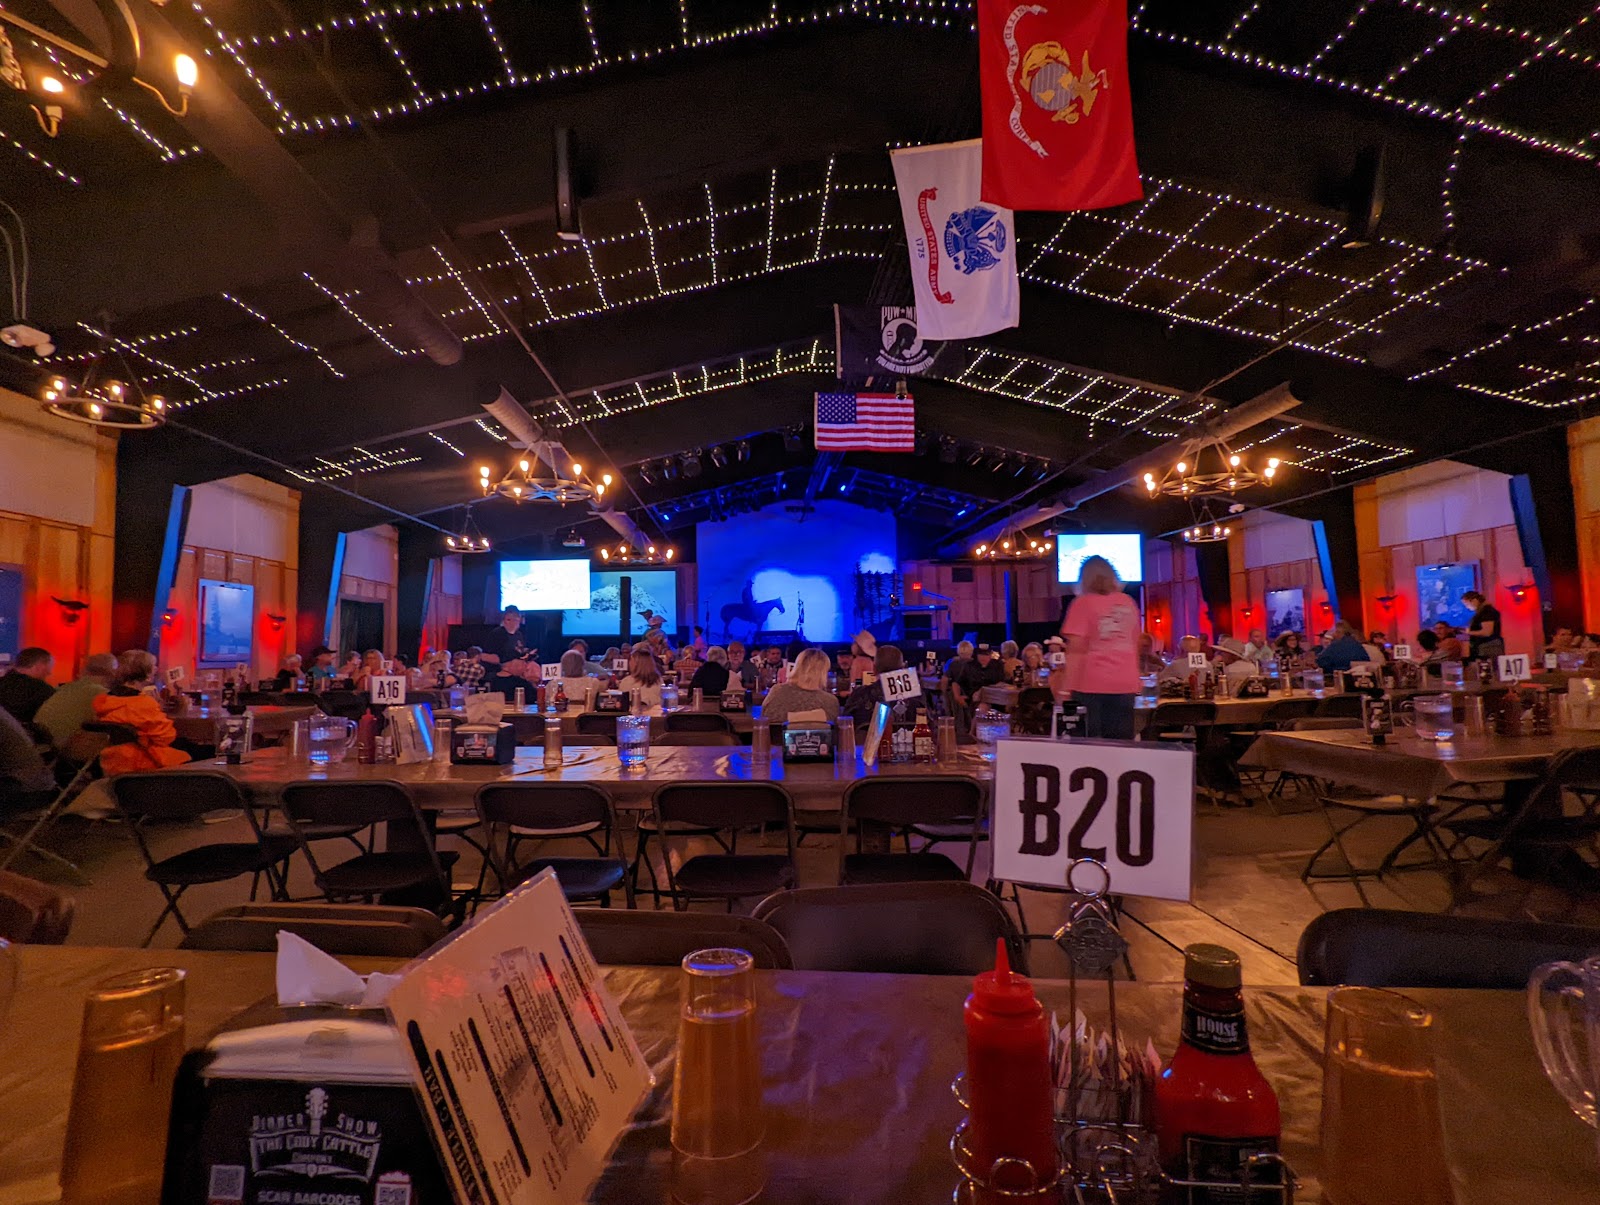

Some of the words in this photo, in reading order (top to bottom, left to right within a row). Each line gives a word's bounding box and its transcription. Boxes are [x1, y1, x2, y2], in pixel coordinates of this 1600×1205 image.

[919, 197, 931, 229] UNITED
[915, 237, 926, 260] 1775
[927, 231, 938, 265] STATES
[929, 269, 939, 296] ARMY
[545, 666, 558, 677] A12
[1505, 658, 1523, 676] A17
[378, 680, 399, 698] A16
[887, 674, 912, 696] B16
[1018, 762, 1155, 867] B20
[1196, 1015, 1239, 1037] HOUSE
[253, 1112, 304, 1132] DINNER
[336, 1112, 378, 1135] SHOW
[285, 1134, 320, 1151] CODY
[322, 1134, 373, 1159] CATTLE
[294, 1192, 361, 1205] BARCODES
